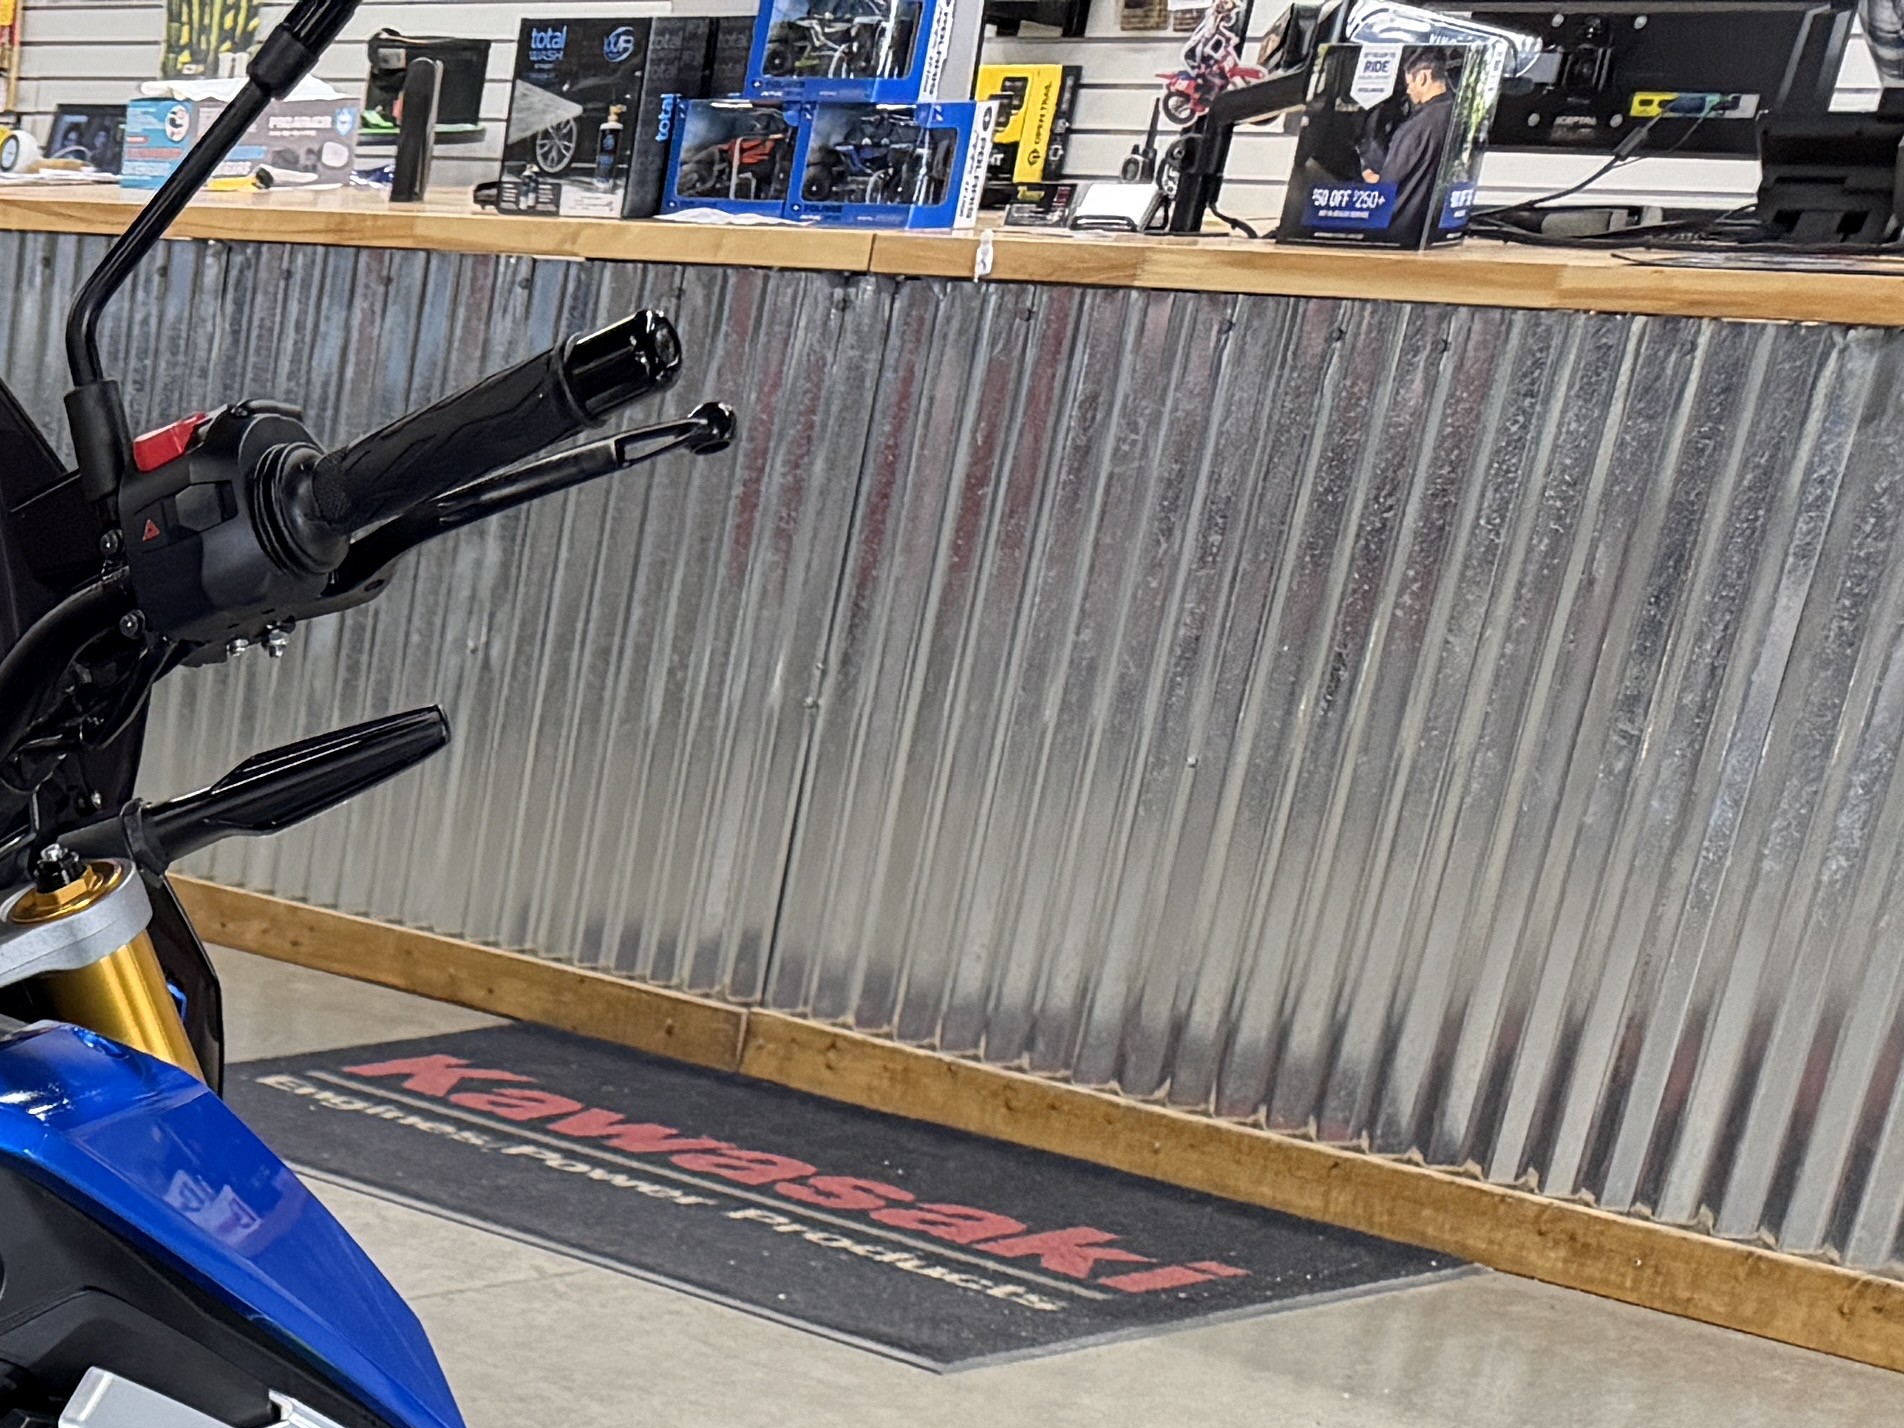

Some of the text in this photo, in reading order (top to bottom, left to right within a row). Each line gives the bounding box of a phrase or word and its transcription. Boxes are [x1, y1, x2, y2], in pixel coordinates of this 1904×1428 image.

[530, 25, 568, 49] total
[1363, 60, 1390, 73] RIDE
[341, 1052, 1254, 1294] Kawasaki
[726, 1207, 1071, 1312] Products
